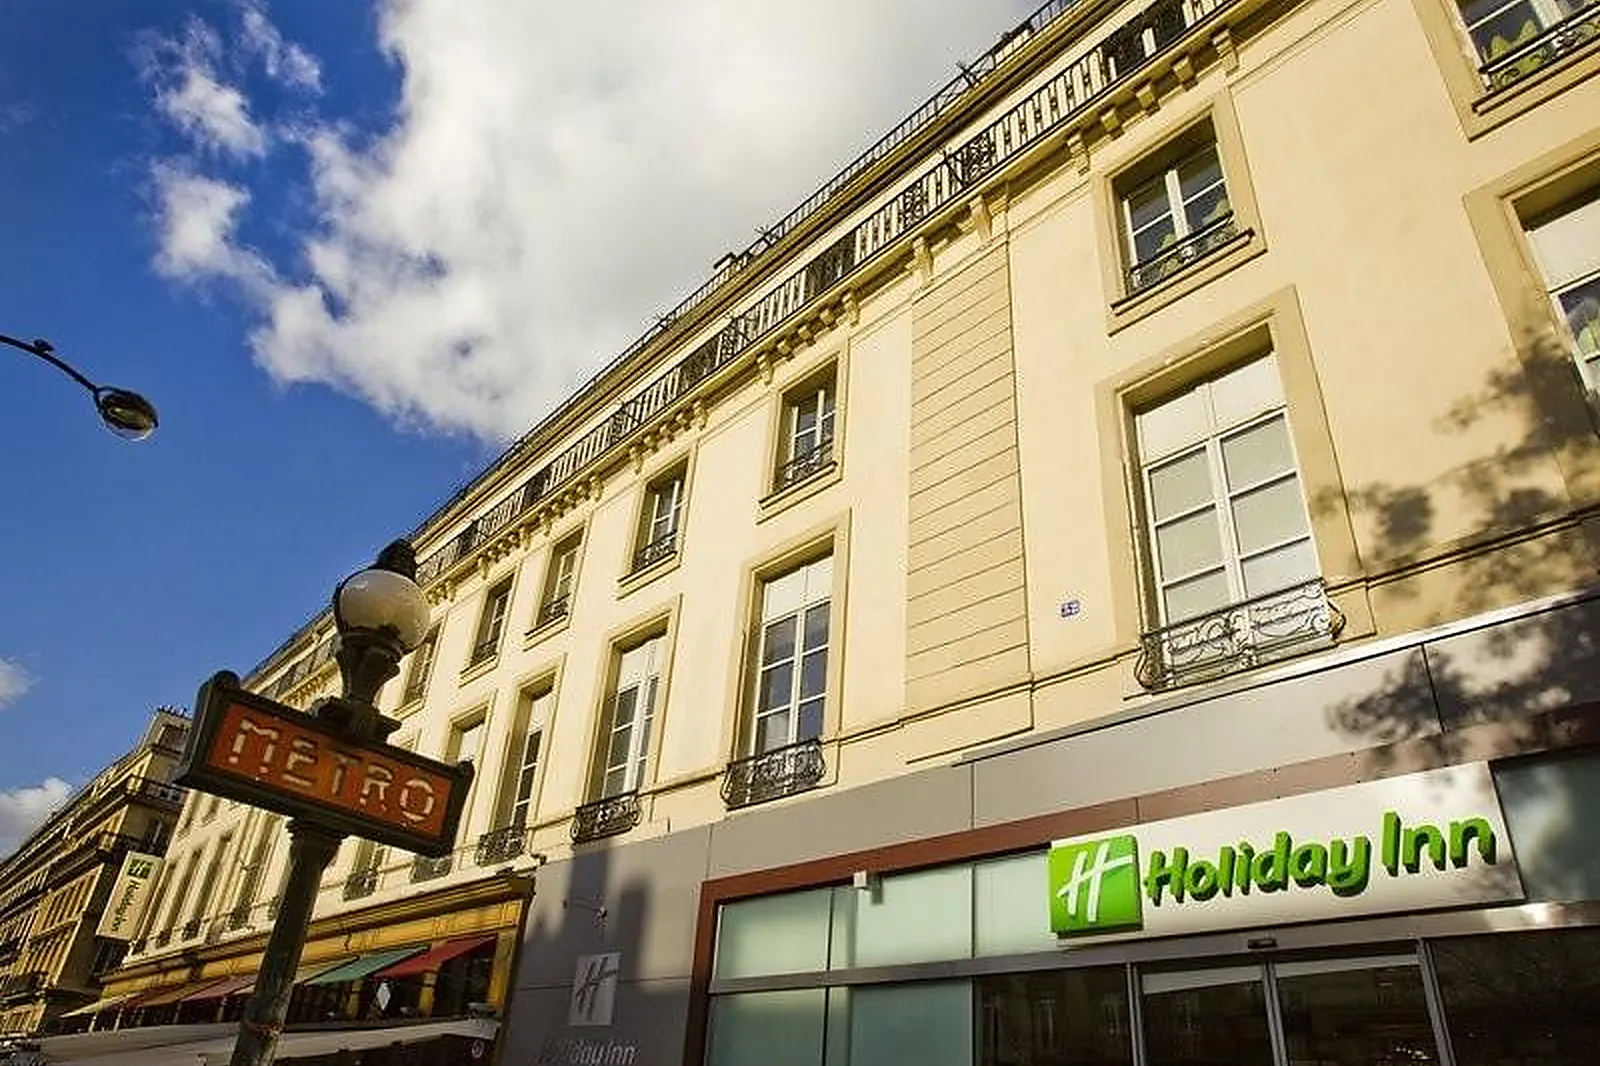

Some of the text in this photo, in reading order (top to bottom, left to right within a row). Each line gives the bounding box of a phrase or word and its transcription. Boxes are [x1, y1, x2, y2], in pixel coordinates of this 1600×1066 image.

[228, 718, 435, 822] METRO
[1144, 831, 1372, 906] Holiday
[1382, 811, 1496, 877] Inn
